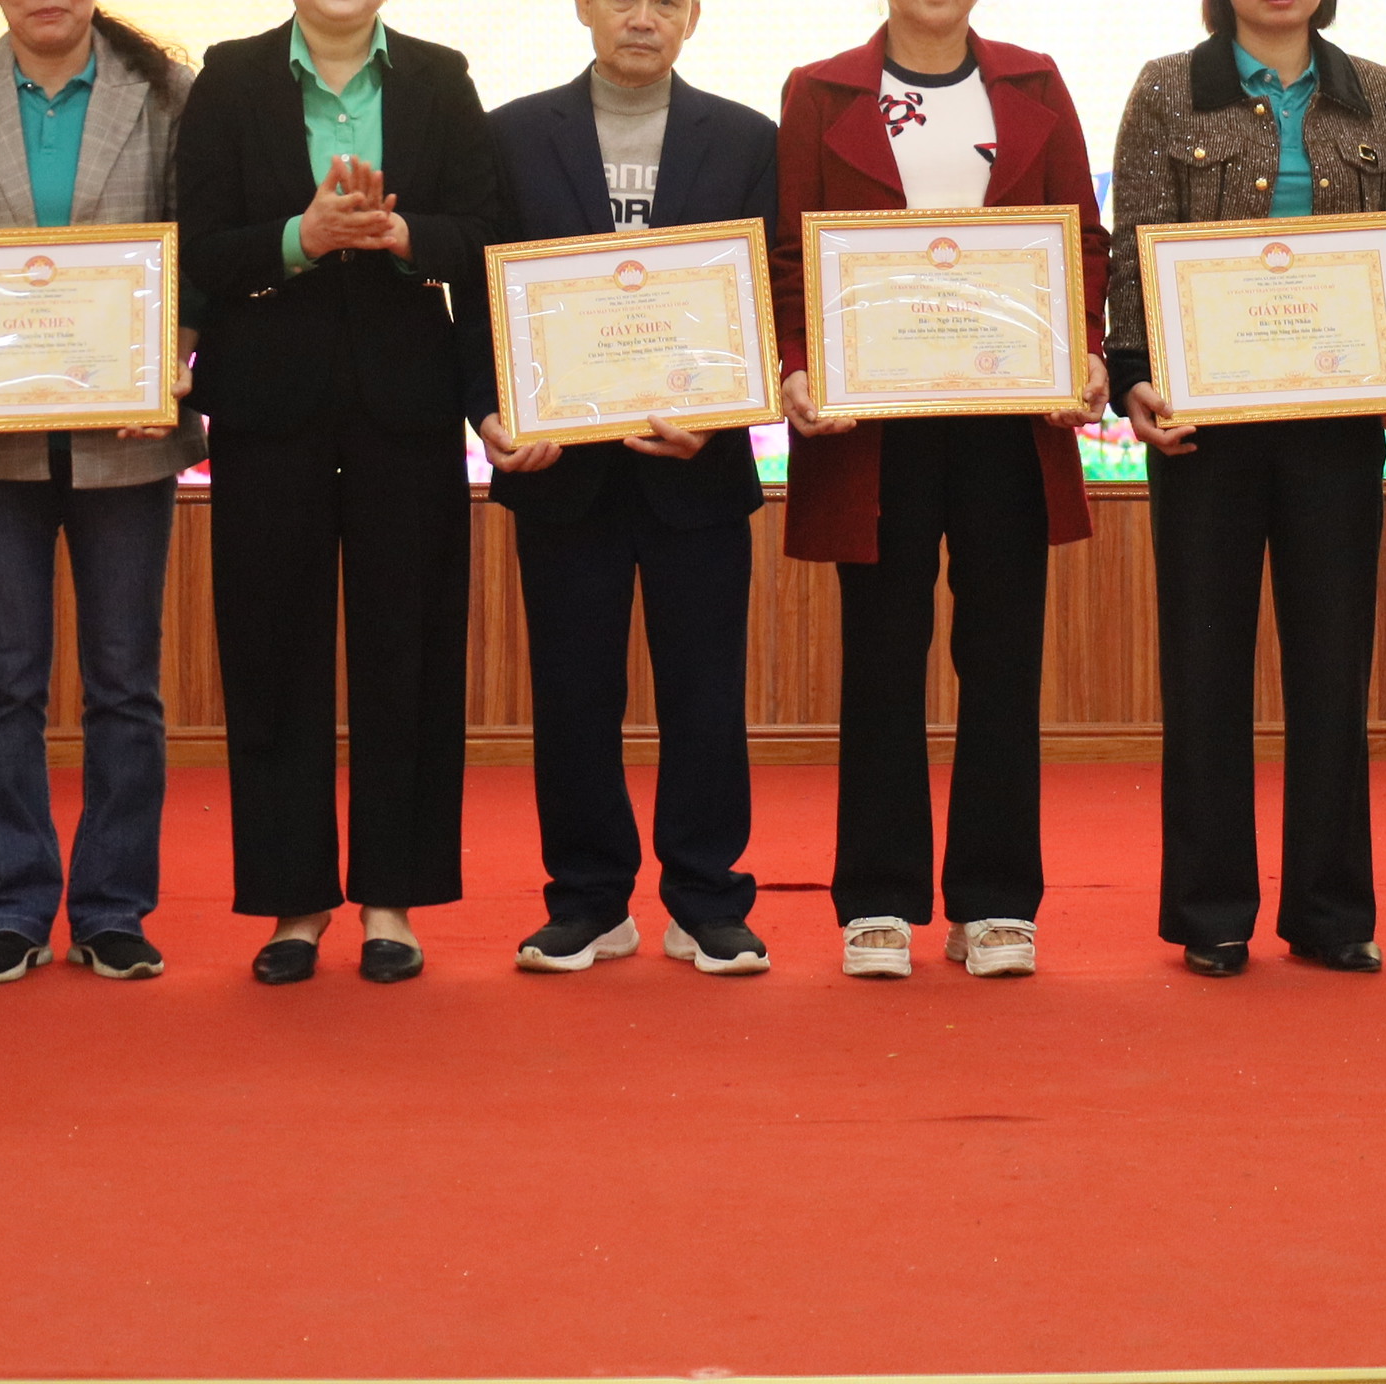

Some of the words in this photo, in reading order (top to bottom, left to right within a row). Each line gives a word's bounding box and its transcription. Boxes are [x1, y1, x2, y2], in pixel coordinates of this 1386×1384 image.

[1283, 302, 1319, 315] KHEN
[39, 317, 75, 328] KHEN
[636, 320, 672, 334] KHEN
